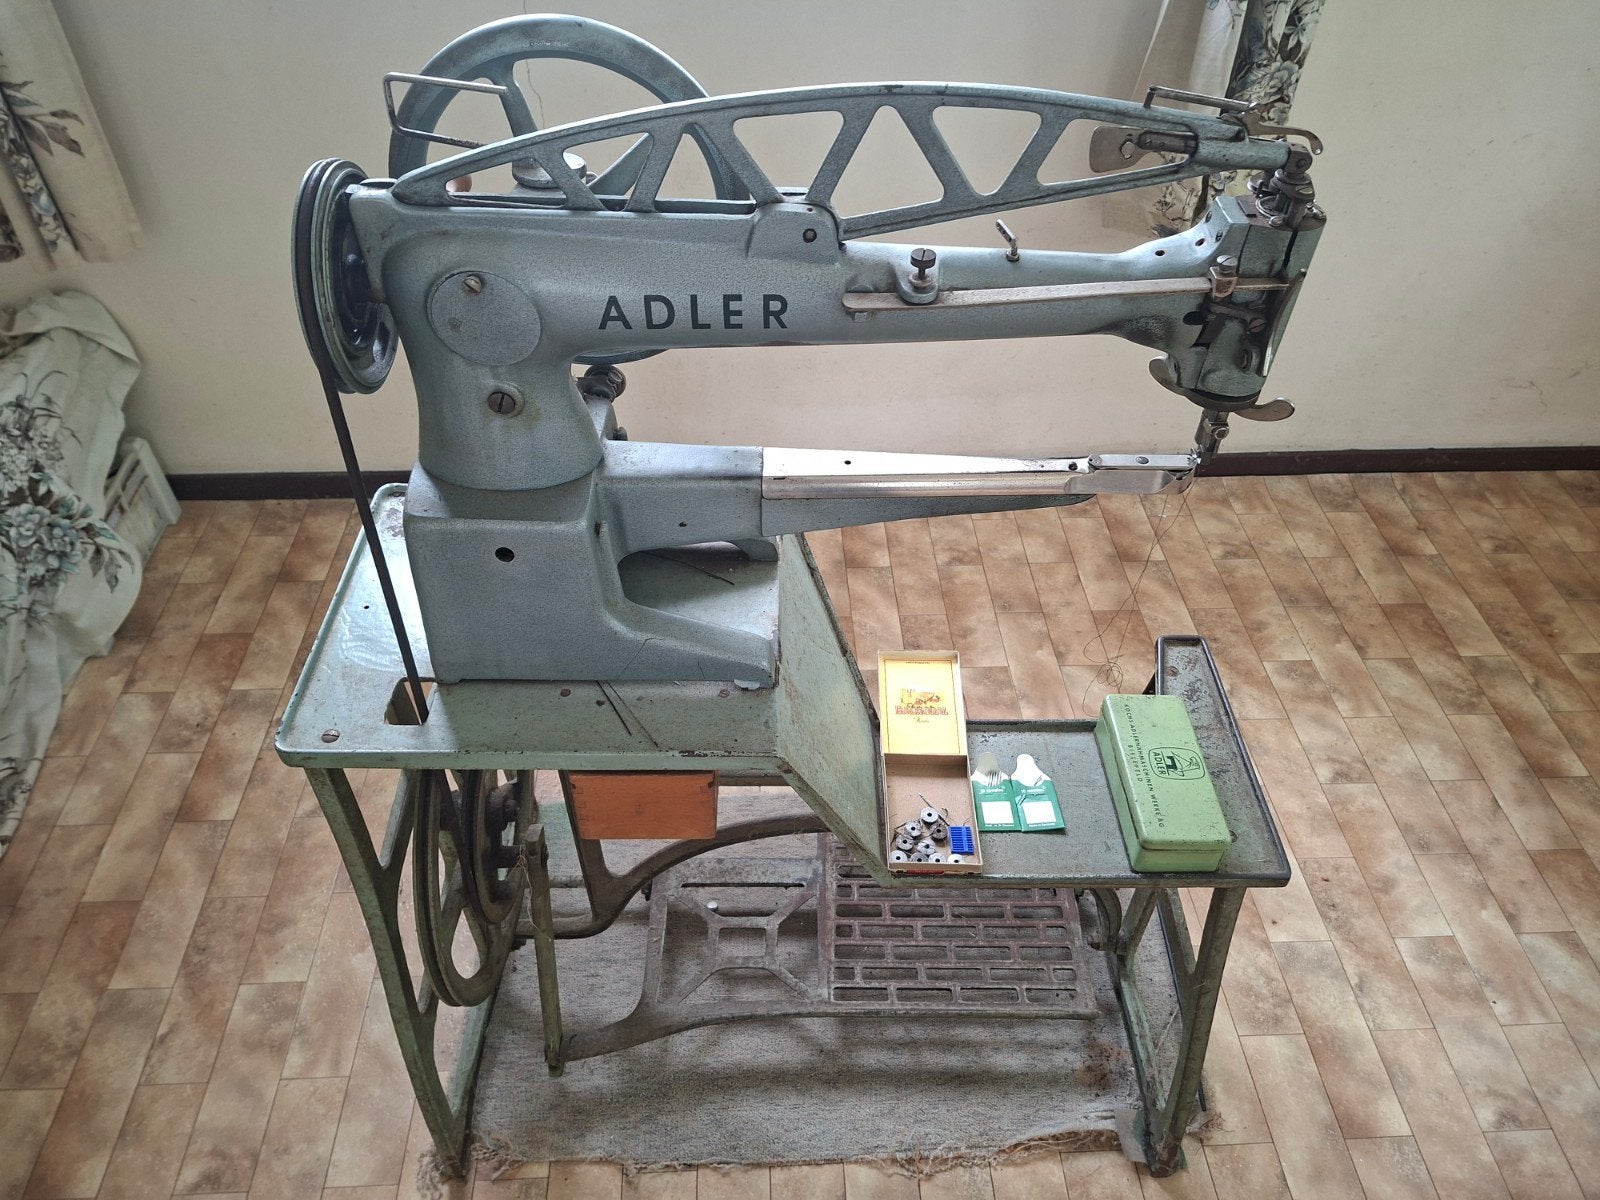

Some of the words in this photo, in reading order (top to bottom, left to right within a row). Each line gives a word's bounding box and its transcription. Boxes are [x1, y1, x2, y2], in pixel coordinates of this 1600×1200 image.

[598, 294, 788, 329] ADLER
[1153, 751, 1167, 775] ADLER
[1150, 794, 1161, 815] WERKE
